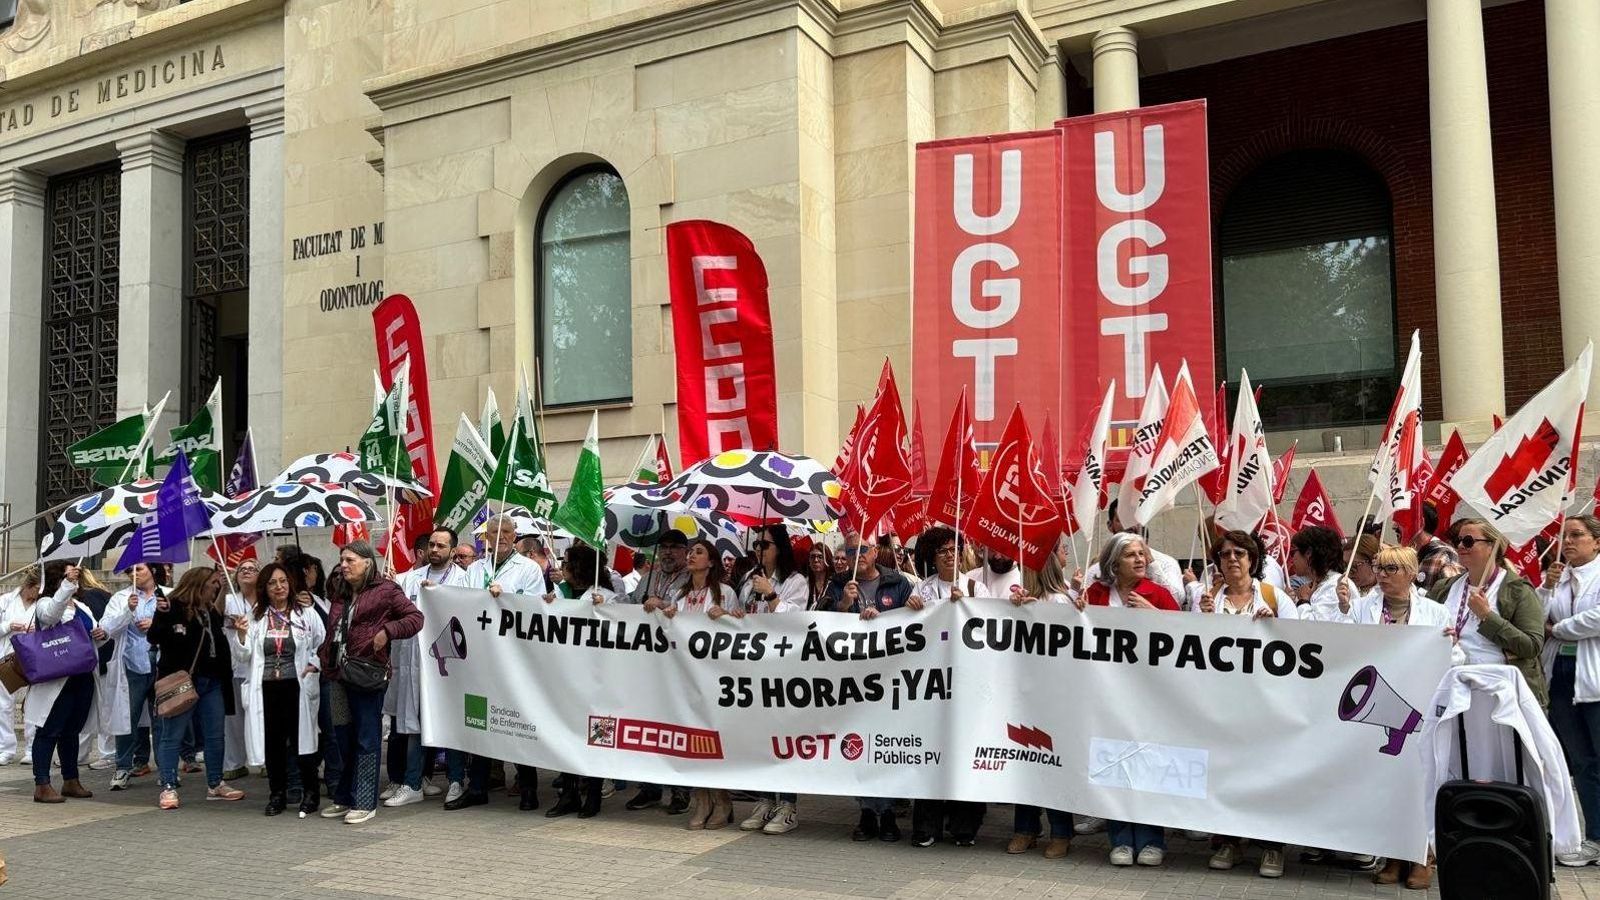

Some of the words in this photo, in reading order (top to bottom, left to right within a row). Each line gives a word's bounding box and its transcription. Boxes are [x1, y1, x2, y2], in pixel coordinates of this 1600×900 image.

[51, 88, 80, 118] DE
[97, 45, 225, 104] MEDICINA
[292, 230, 343, 261] FACULTAT
[350, 225, 366, 250] DE
[355, 254, 361, 277] I
[1094, 124, 1169, 399] UGT
[320, 279, 384, 313] ODONTOLOG
[951, 149, 1022, 422] UGT
[476, 610, 492, 631] +
[498, 608, 670, 653] PLANTILLAS
[688, 630, 769, 661] OPES
[773, 636, 793, 657] +
[800, 622, 926, 662] ÁGILES
[961, 616, 1139, 664] CUMPLIR
[1148, 631, 1325, 680] PACTOS
[718, 676, 753, 708] 35
[761, 673, 885, 708] HORAS
[892, 667, 953, 711] ¡YA!
[465, 716, 486, 727] SATSE
[490, 705, 520, 719] Sindicato
[490, 716, 499, 726] de
[623, 725, 688, 752] CCOO
[771, 733, 836, 760] UGT
[874, 733, 922, 748] Serveis
[874, 750, 922, 765] Públics
[924, 752, 942, 765] PV
[972, 759, 1007, 771] SALUT
[975, 746, 1063, 767] INTERSINDICAL
